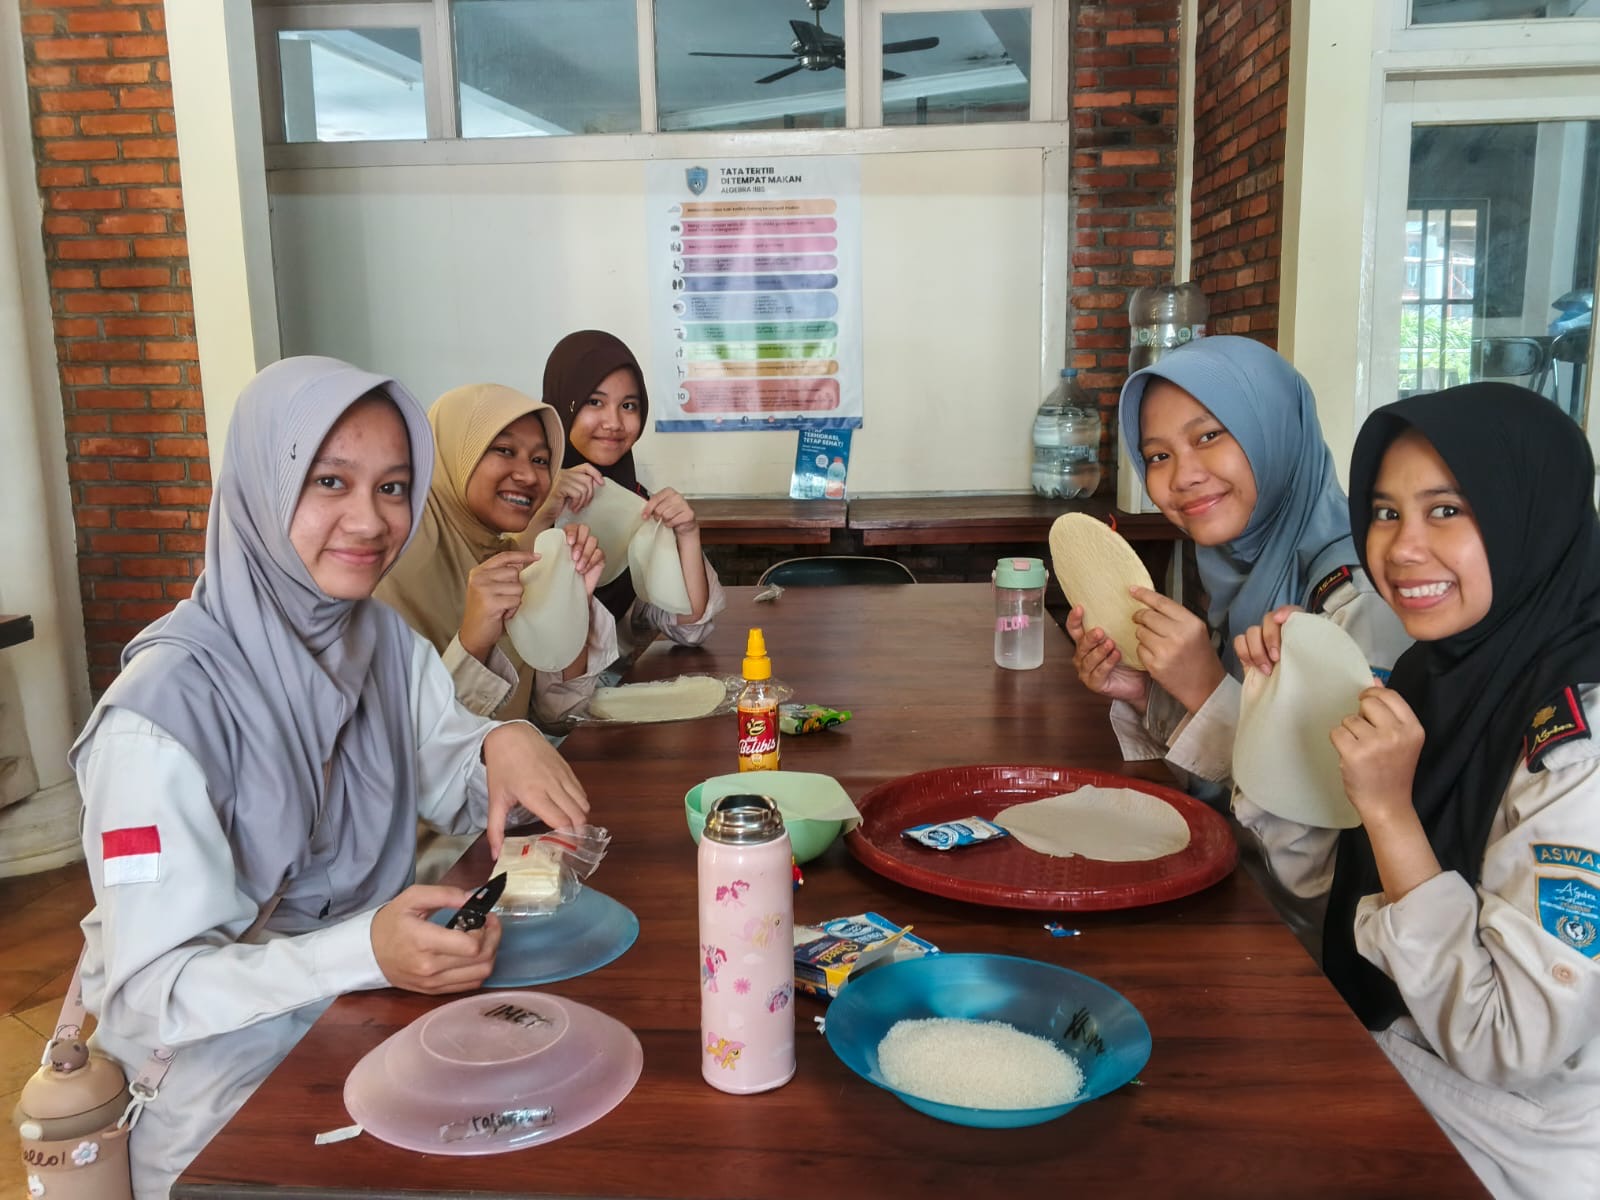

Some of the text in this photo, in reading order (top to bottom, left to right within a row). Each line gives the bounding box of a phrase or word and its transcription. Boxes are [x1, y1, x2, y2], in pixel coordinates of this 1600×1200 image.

[720, 167, 744, 176] TATA
[731, 176, 767, 184] TEMPAT
[768, 175, 802, 183] MAKAN
[1541, 847, 1600, 870] ASWA
